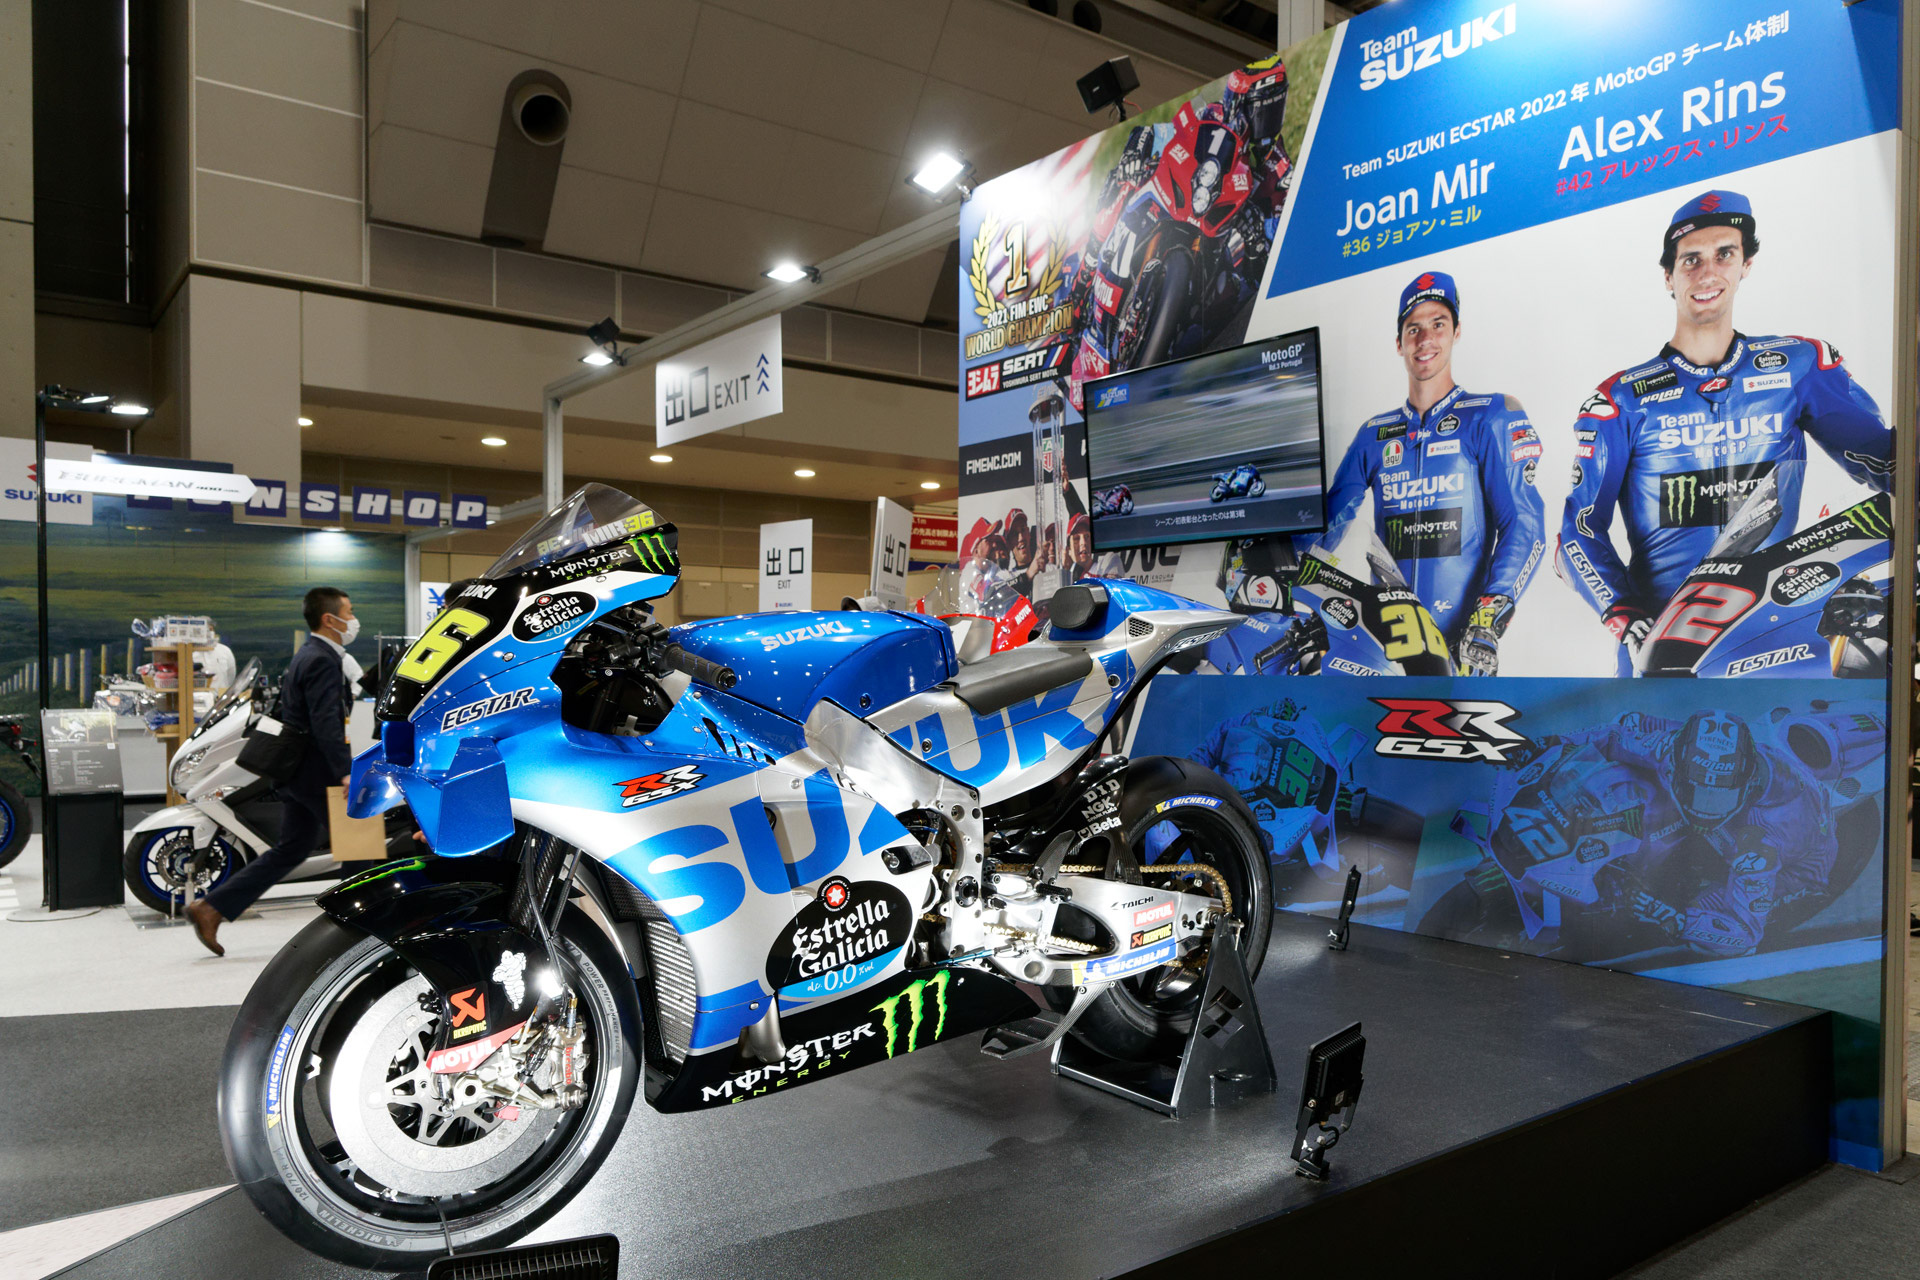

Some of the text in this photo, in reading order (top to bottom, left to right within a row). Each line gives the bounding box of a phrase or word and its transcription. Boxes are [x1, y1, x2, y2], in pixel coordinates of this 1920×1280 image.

[1360, 26, 1417, 62] Team
[1360, 2, 1516, 91] SUZUKI
[1342, 157, 1382, 180] Team
[1386, 131, 1445, 166] SUZUKI
[1450, 108, 1515, 144] ECSTAR
[1520, 90, 1567, 121] 2022
[1594, 52, 1676, 95] MotoGP
[1681, 10, 1789, 66] チーム体制
[1558, 71, 1786, 170] Alex Rins
[1556, 114, 1789, 196] #42 アレックス・リンス
[1336, 159, 1495, 236] Joan Mir
[1342, 205, 1481, 257] #36 ジョアン・ミル
[987, 294, 1049, 328] 2021 FIM EWC
[965, 303, 1074, 360] WORLD CHAMPION
[1002, 350, 1048, 376] SERT
[1672, 356, 1708, 376] SUZUKI
[665, 365, 750, 426] 出口 EXIT
[1640, 387, 1684, 405] NOLAN
[1756, 378, 1788, 387] SUZUKI
[1657, 412, 1706, 429] Team
[1658, 413, 1782, 449] SUZUKI
[966, 451, 1021, 475] FIMEWC.COM
[1695, 441, 1747, 459] MotoGP
[1379, 471, 1409, 485] Team
[1382, 473, 1464, 501] SUZUKI
[1700, 477, 1777, 498] MONSTER
[304, 489, 485, 522] SHOP
[1401, 496, 1435, 510] MotoGP
[624, 510, 656, 533] 36
[1404, 520, 1457, 534] MONSTER
[1786, 520, 1855, 552] MONSTER
[551, 549, 632, 578] MONSTER
[766, 547, 804, 576] 出口
[883, 533, 907, 578] 出口
[566, 562, 622, 580] ENERGY
[778, 579, 791, 589] EXIT
[1318, 568, 1353, 589] MONSTER
[1564, 540, 1614, 601] ECSTAR
[1778, 565, 1825, 593] Estrella
[460, 585, 498, 600] ZUKI
[1377, 590, 1420, 602] SUZUK
[1786, 574, 1830, 600] Galicia
[523, 596, 580, 626] Estrella
[530, 606, 583, 633] Galicia
[1014, 605, 1032, 626] MOTUL
[761, 620, 848, 652] SUZUKI
[1380, 603, 1450, 661] 36
[1727, 644, 1815, 677] ECSTAR
[440, 686, 540, 734] ECSTAR
[1374, 736, 1522, 762] GSX
[1269, 747, 1282, 787] SUZUKI
[1279, 741, 1316, 807] 36
[1692, 755, 1735, 775] NOLAN
[621, 779, 700, 808] GSX
[1081, 796, 1115, 820] NGK
[1172, 797, 1218, 807] MICHELIN
[1537, 790, 1570, 829] SUZUKI
[1090, 815, 1122, 836] Beta
[1502, 806, 1571, 861] 42
[1538, 878, 1581, 897] ECSTAR
[1121, 896, 1154, 909] TAICHI
[1135, 904, 1173, 925] MOTUL
[792, 899, 891, 960] Estrella
[799, 928, 889, 978] Galicia
[1107, 946, 1170, 974] MICHELIN
[582, 962, 604, 989] POWER
[824, 963, 857, 991] 0,0
[268, 1033, 292, 1101] MICHELIN
[430, 1039, 497, 1073] MOTUL
[565, 1047, 573, 1085] brembo
[701, 1022, 877, 1102] MONSTER
[732, 1050, 851, 1104] ENERGY
[286, 1173, 309, 1201] 120/70
[319, 1209, 383, 1243] MICHELIN
